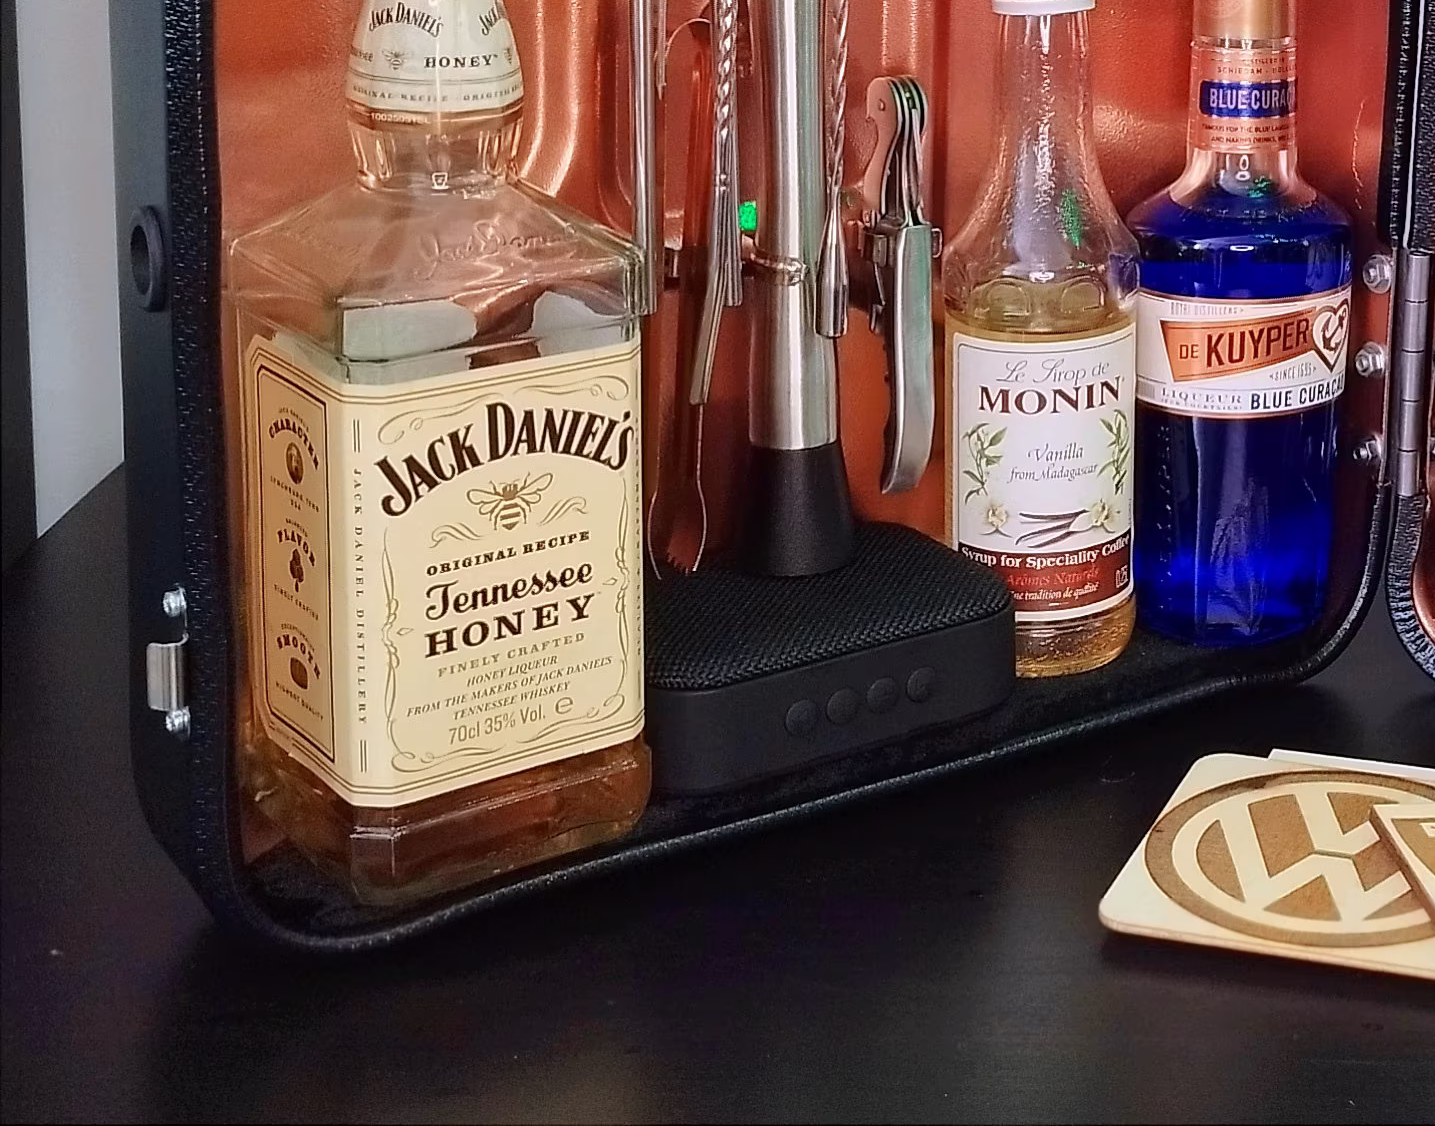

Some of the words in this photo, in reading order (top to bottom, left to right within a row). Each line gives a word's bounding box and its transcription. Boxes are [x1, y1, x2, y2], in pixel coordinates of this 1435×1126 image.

[369, 9, 395, 32] JACK
[395, 1, 444, 38] DANIEL'S
[424, 54, 493, 69] HONEY
[1209, 87, 1248, 110] BLUE
[1179, 343, 1199, 360] DE
[1206, 317, 1310, 369] KUYPER
[996, 360, 1028, 383] Le
[1033, 358, 1086, 386] Sirop
[1091, 361, 1110, 377] de
[978, 375, 1121, 415] MONIN
[1161, 387, 1243, 404] LIQUEUR
[1250, 390, 1293, 411] BLUE
[374, 422, 485, 517] JACK
[485, 402, 635, 471] DANIEL'S
[1027, 442, 1084, 462] Vanilla
[353, 467, 363, 515] JACK
[1007, 466, 1037, 485] from
[1035, 463, 1099, 482] Madagascar
[277, 528, 316, 567] FLAVOR
[354, 526, 365, 598] DANIEL
[426, 547, 517, 577] ORIGINAL
[523, 530, 590, 555] RECIPE
[961, 545, 997, 567] Syrup
[1000, 553, 1022, 568] for
[1025, 548, 1100, 571] Speciality
[425, 562, 593, 621] Tennessee
[424, 593, 595, 658] HONEY
[276, 633, 321, 681] SMOOTH
[356, 608, 368, 724] DISTILLERY
[437, 653, 501, 678] FINELY
[506, 632, 585, 659] CRAFTED
[466, 667, 506, 688] HONEY
[508, 655, 559, 677] LIQUEUR
[406, 701, 441, 718] FROM
[444, 694, 468, 708] THE
[470, 681, 518, 701] MAKERS
[520, 675, 536, 688] OF
[535, 667, 564, 686] JACK
[565, 655, 613, 677] DANIEL'S
[453, 695, 517, 721] TENNESSEE
[519, 680, 571, 703] WHISKEY
[449, 722, 481, 745] 70cl
[484, 711, 517, 736] 35%
[520, 704, 547, 725] Vol.
